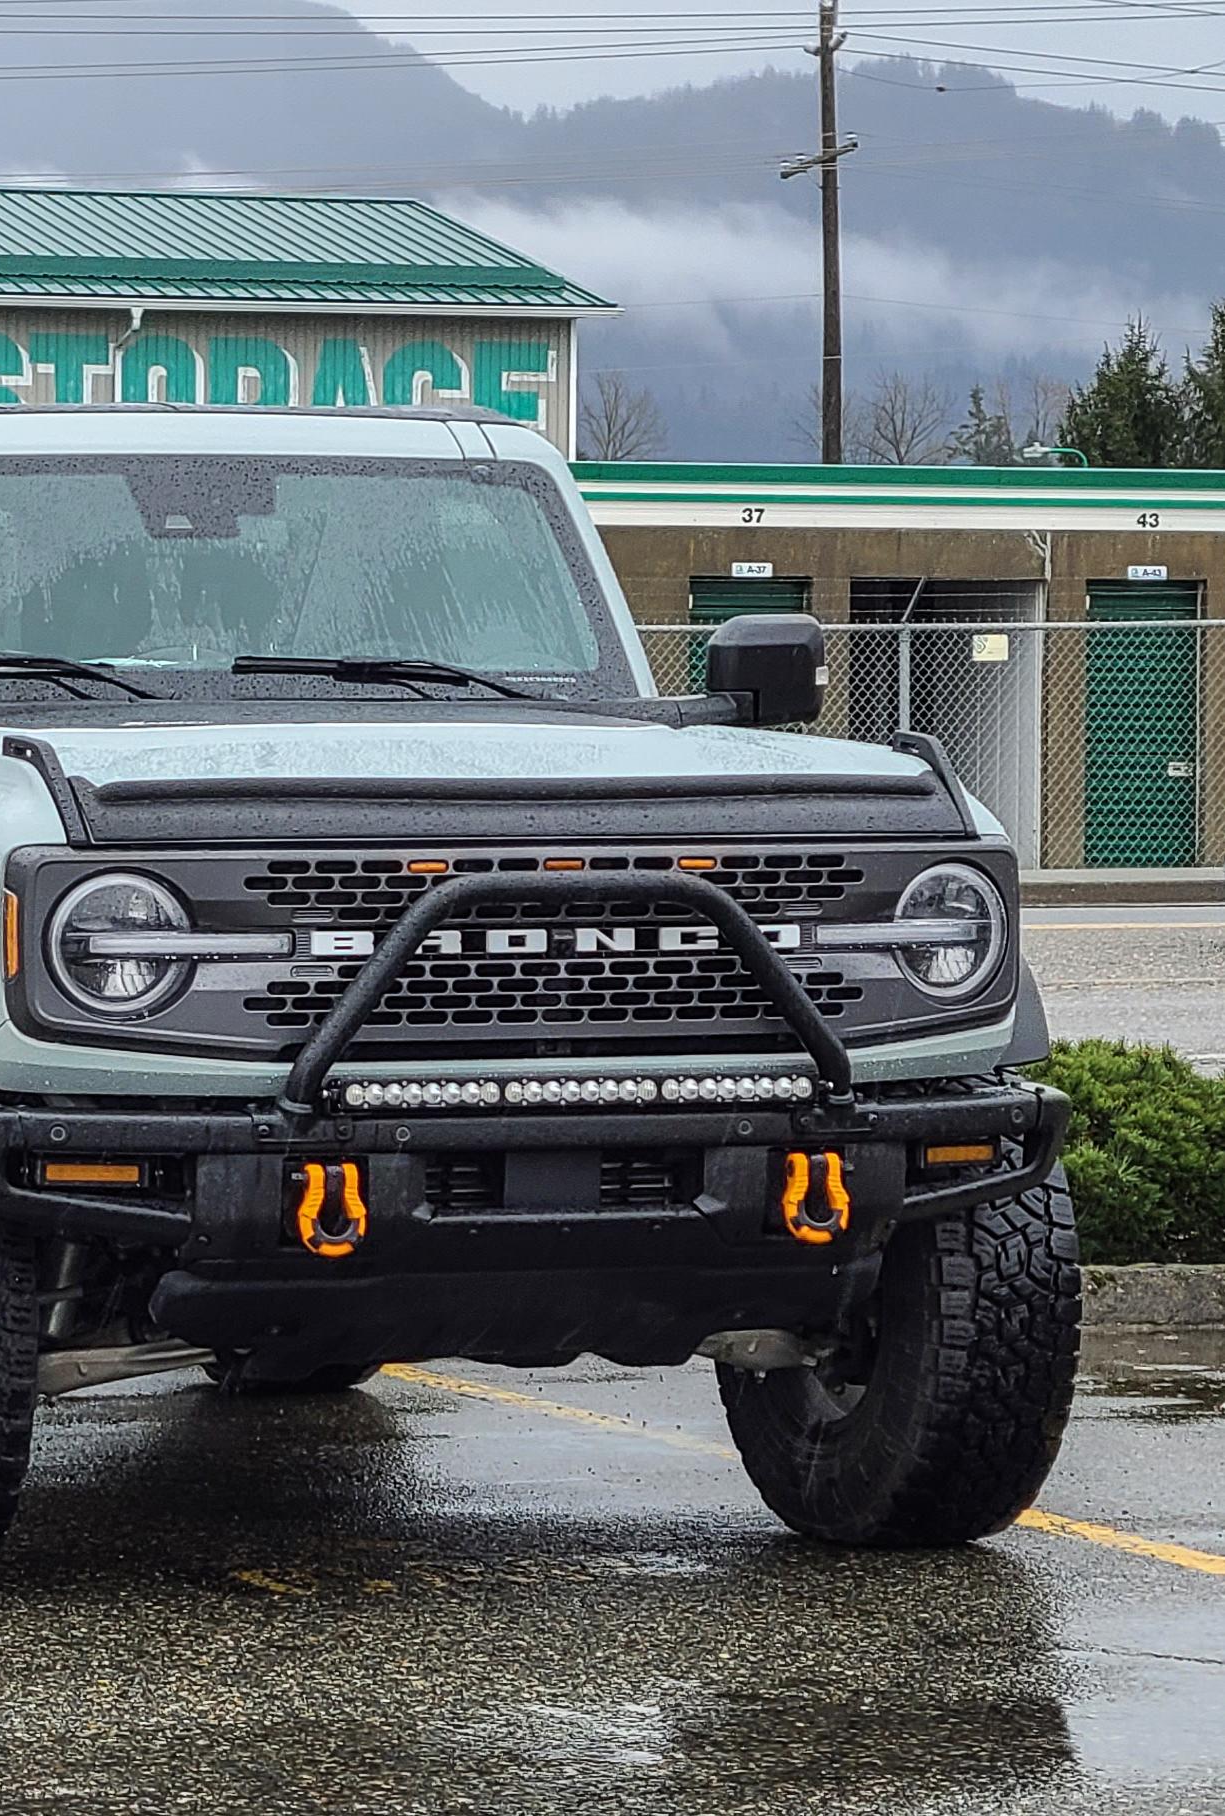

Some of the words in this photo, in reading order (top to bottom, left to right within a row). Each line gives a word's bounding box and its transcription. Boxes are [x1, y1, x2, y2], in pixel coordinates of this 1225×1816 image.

[741, 507, 765, 523] 37
[1136, 512, 1160, 528] 43
[747, 565, 767, 574] A-37
[310, 924, 801, 957] BRONCO
